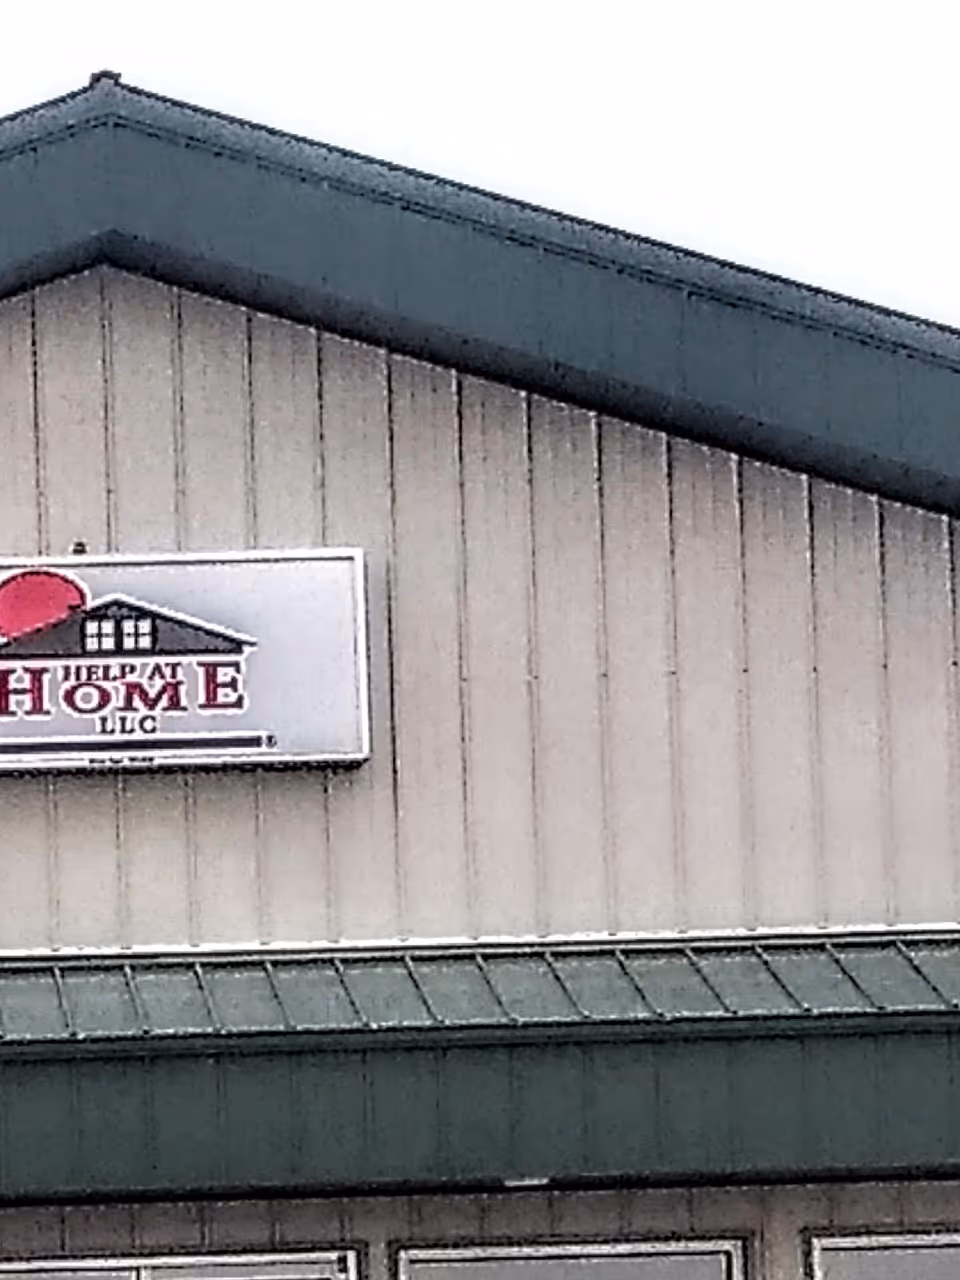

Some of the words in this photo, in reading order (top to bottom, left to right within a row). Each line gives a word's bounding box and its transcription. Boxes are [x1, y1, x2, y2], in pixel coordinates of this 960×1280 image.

[63, 665, 137, 682] HELP
[148, 663, 181, 680] AT
[99, 716, 157, 734] LLC
